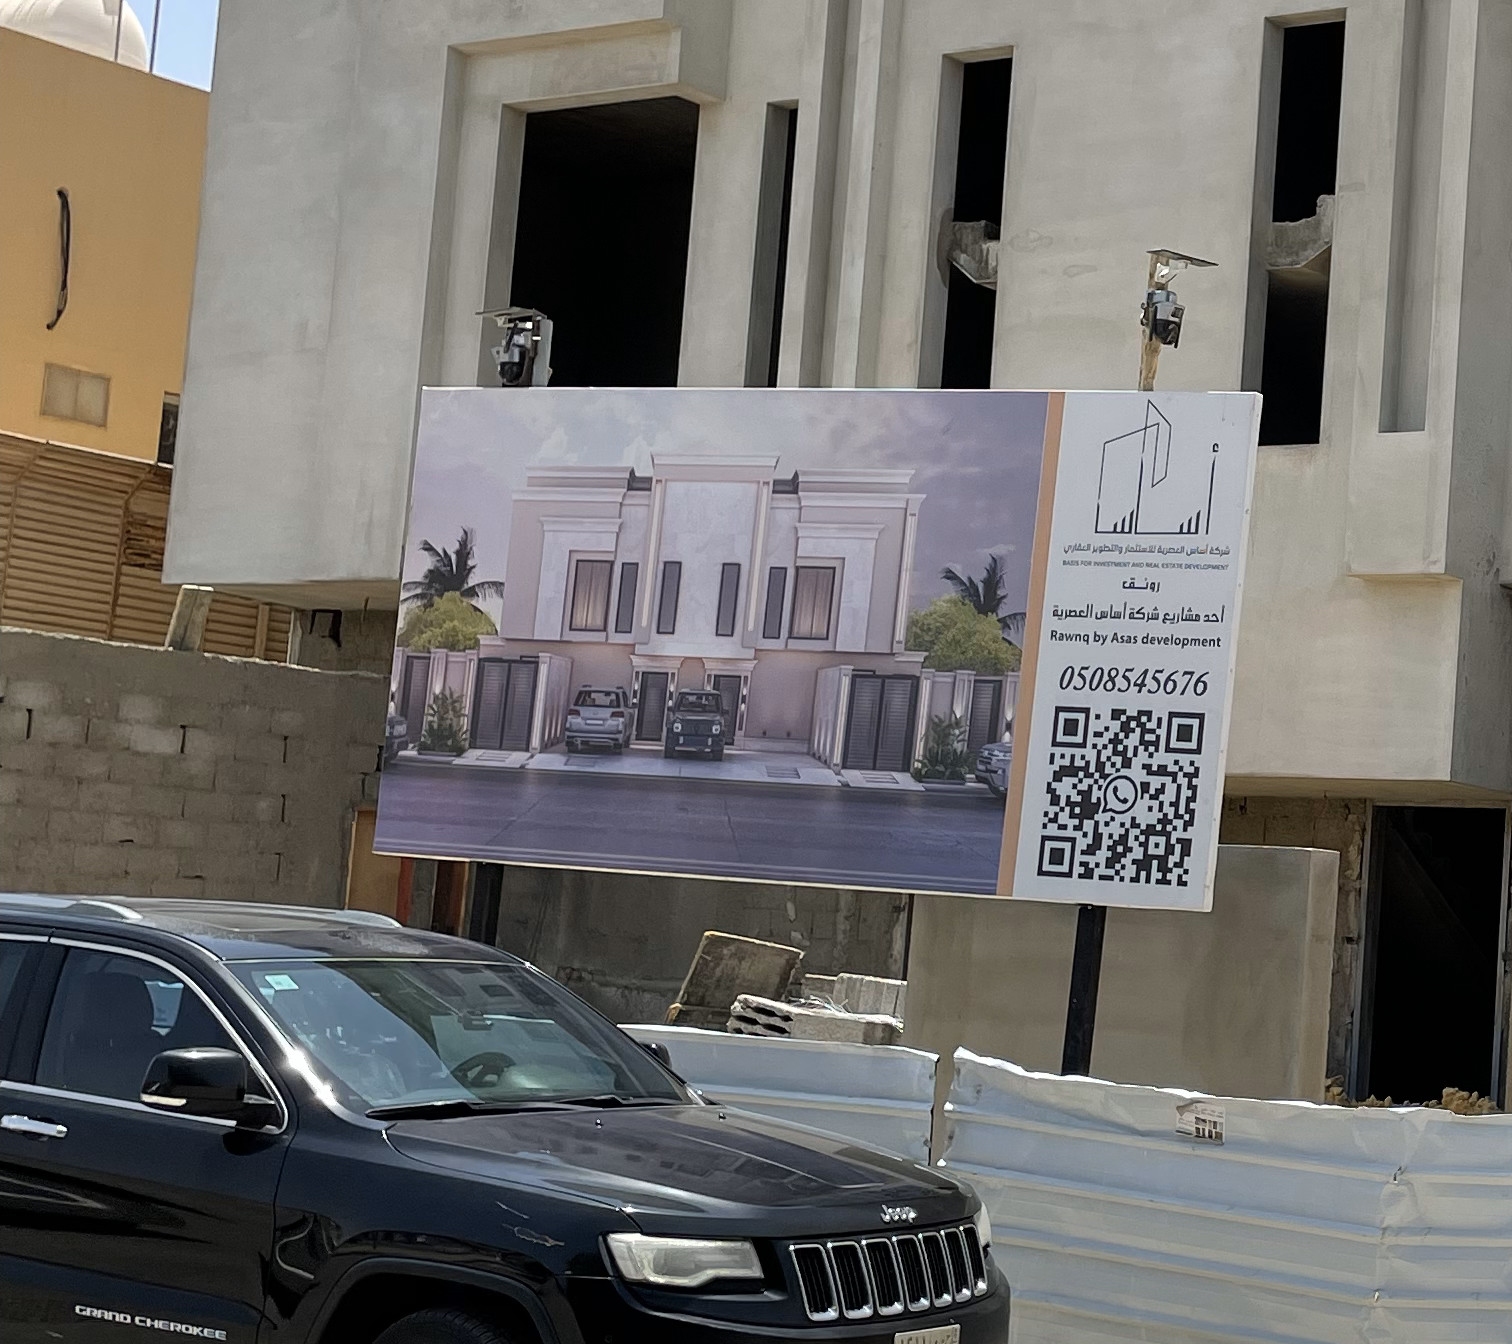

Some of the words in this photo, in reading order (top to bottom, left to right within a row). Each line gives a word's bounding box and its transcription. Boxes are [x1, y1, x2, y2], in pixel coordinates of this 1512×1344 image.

[1063, 542, 1092, 555] العقاري
[1091, 543, 1124, 555] والتطوير
[1157, 544, 1185, 556] العصرية
[1185, 543, 1209, 556] أساس
[1208, 545, 1231, 558] شركة
[1093, 560, 1130, 568] INVESTMENT
[1131, 561, 1145, 569] AND
[1161, 562, 1184, 570] ESTATE
[1184, 563, 1230, 571] DEVELOPMENT
[1052, 603, 1094, 621] العصرية
[1094, 601, 1127, 620] أساس
[1128, 606, 1160, 623] شركة
[1161, 606, 1201, 625] مشاريع
[1203, 604, 1226, 623] أحد
[1050, 629, 1090, 646] Rawnq
[1093, 630, 1109, 646] by
[1110, 631, 1139, 645] Asas
[1141, 632, 1222, 650] development
[1059, 665, 1210, 697] 0508545676
[880, 1204, 917, 1223] Jeep
[75, 1305, 131, 1324] GRAND
[134, 1316, 227, 1341] CHEROKEE
